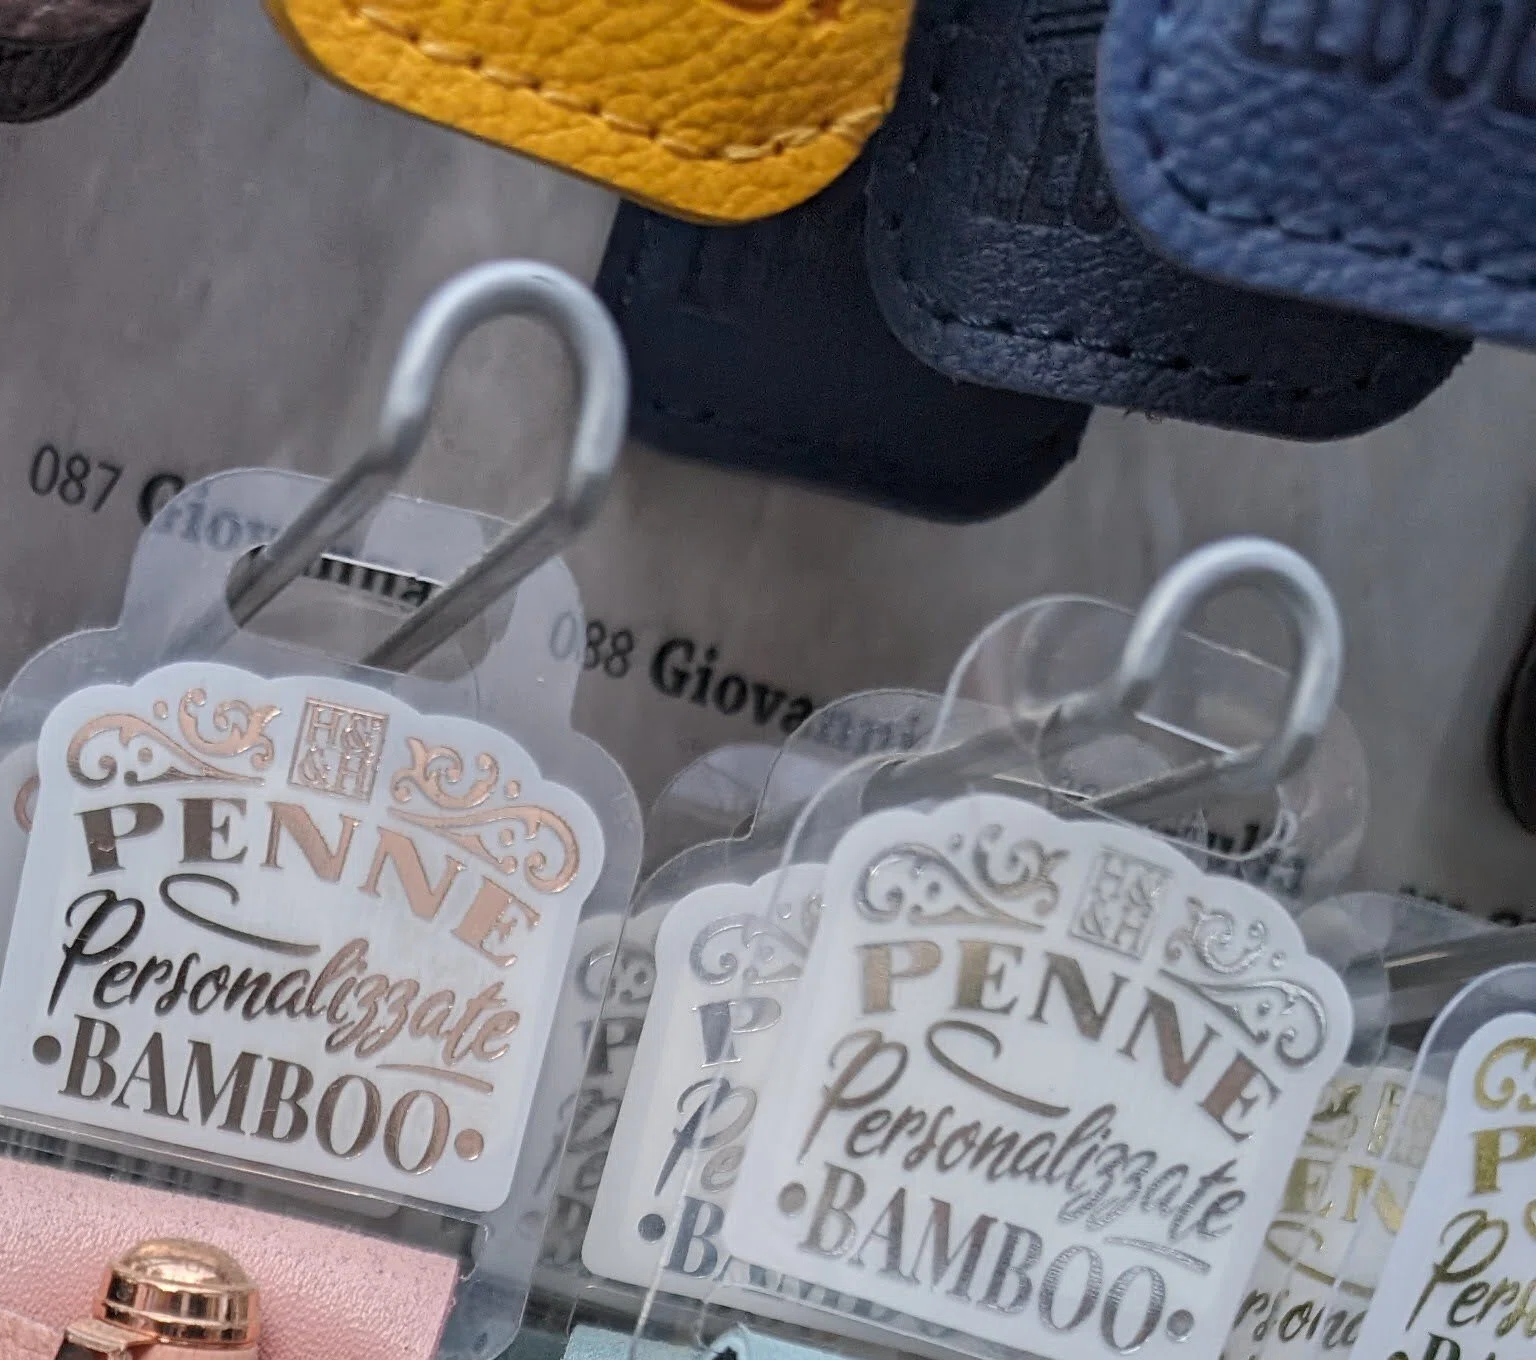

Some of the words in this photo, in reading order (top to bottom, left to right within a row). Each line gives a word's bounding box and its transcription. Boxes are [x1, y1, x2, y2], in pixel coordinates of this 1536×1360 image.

[28, 443, 124, 513] 087
[47, 873, 521, 1067] Personalizzate
[74, 796, 541, 969] PENNE
[58, 1013, 452, 1177] BAMBOO
[797, 1020, 1247, 1242] Personalizzate
[855, 936, 1284, 1146] PENNE
[797, 1161, 1168, 1356] BAMBOO
